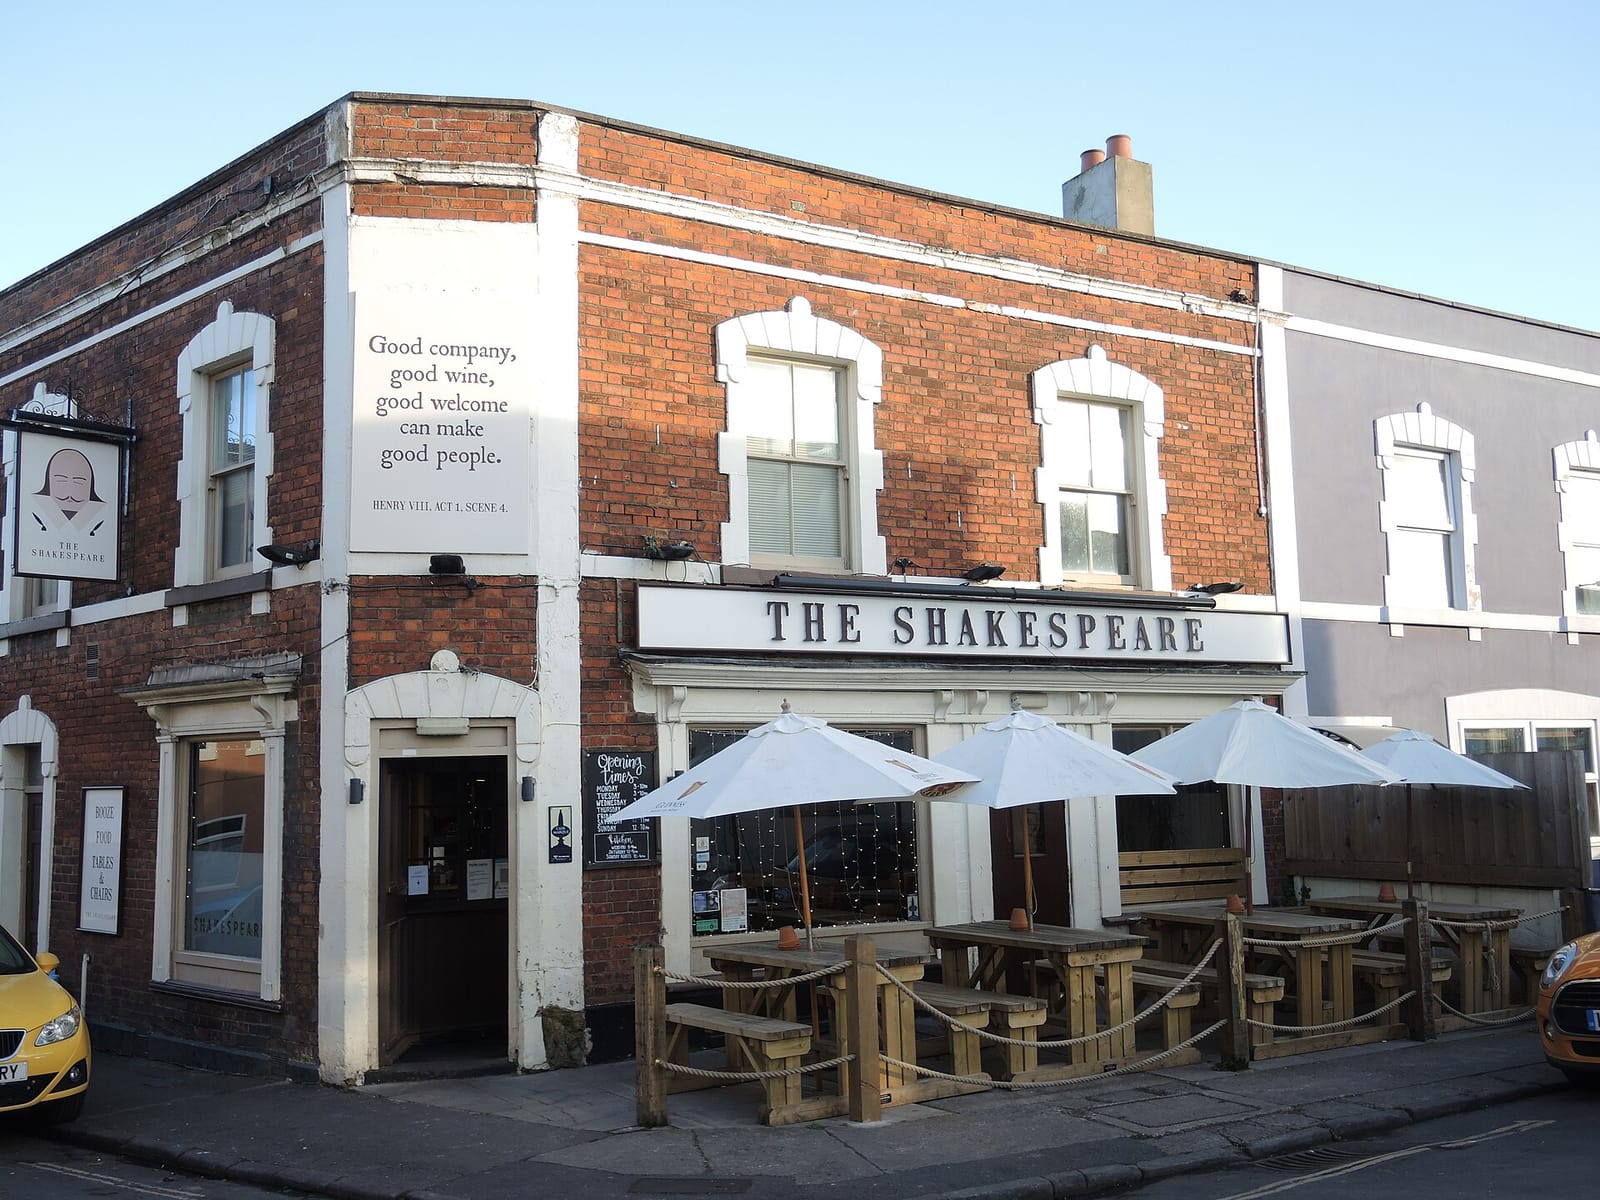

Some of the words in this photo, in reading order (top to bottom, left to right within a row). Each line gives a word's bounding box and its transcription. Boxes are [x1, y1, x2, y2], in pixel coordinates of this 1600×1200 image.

[368, 335, 423, 355] Good
[429, 343, 517, 365] company,
[390, 364, 438, 389] good
[445, 366, 495, 388] wine,
[375, 391, 424, 417] good
[430, 393, 508, 413] welcome
[400, 422, 430, 435] can
[437, 419, 484, 437] make
[381, 444, 429, 469] good
[436, 445, 502, 471] people.
[373, 500, 406, 511] HENRY
[435, 502, 453, 512] ACT
[465, 502, 497, 513] SCENE
[499, 504, 509, 513] 4.
[60, 541, 79, 551] THE
[31, 548, 105, 563] SHAKESPEARE
[766, 601, 861, 643] THE
[893, 605, 1205, 653] SHAKESPEARE
[598, 753, 646, 776] Opening
[600, 767, 639, 785] times
[596, 799, 627, 807] WEDNESDAY
[597, 792, 621, 800] TUESDAY
[95, 806, 115, 820] BOOZE
[597, 825, 617, 833] SUNDAY
[96, 831, 112, 845] FOOD
[92, 855, 114, 870] TABLES
[98, 872, 105, 884] &
[90, 886, 113, 902] CHAIRS
[0, 1064, 18, 1080] RY
